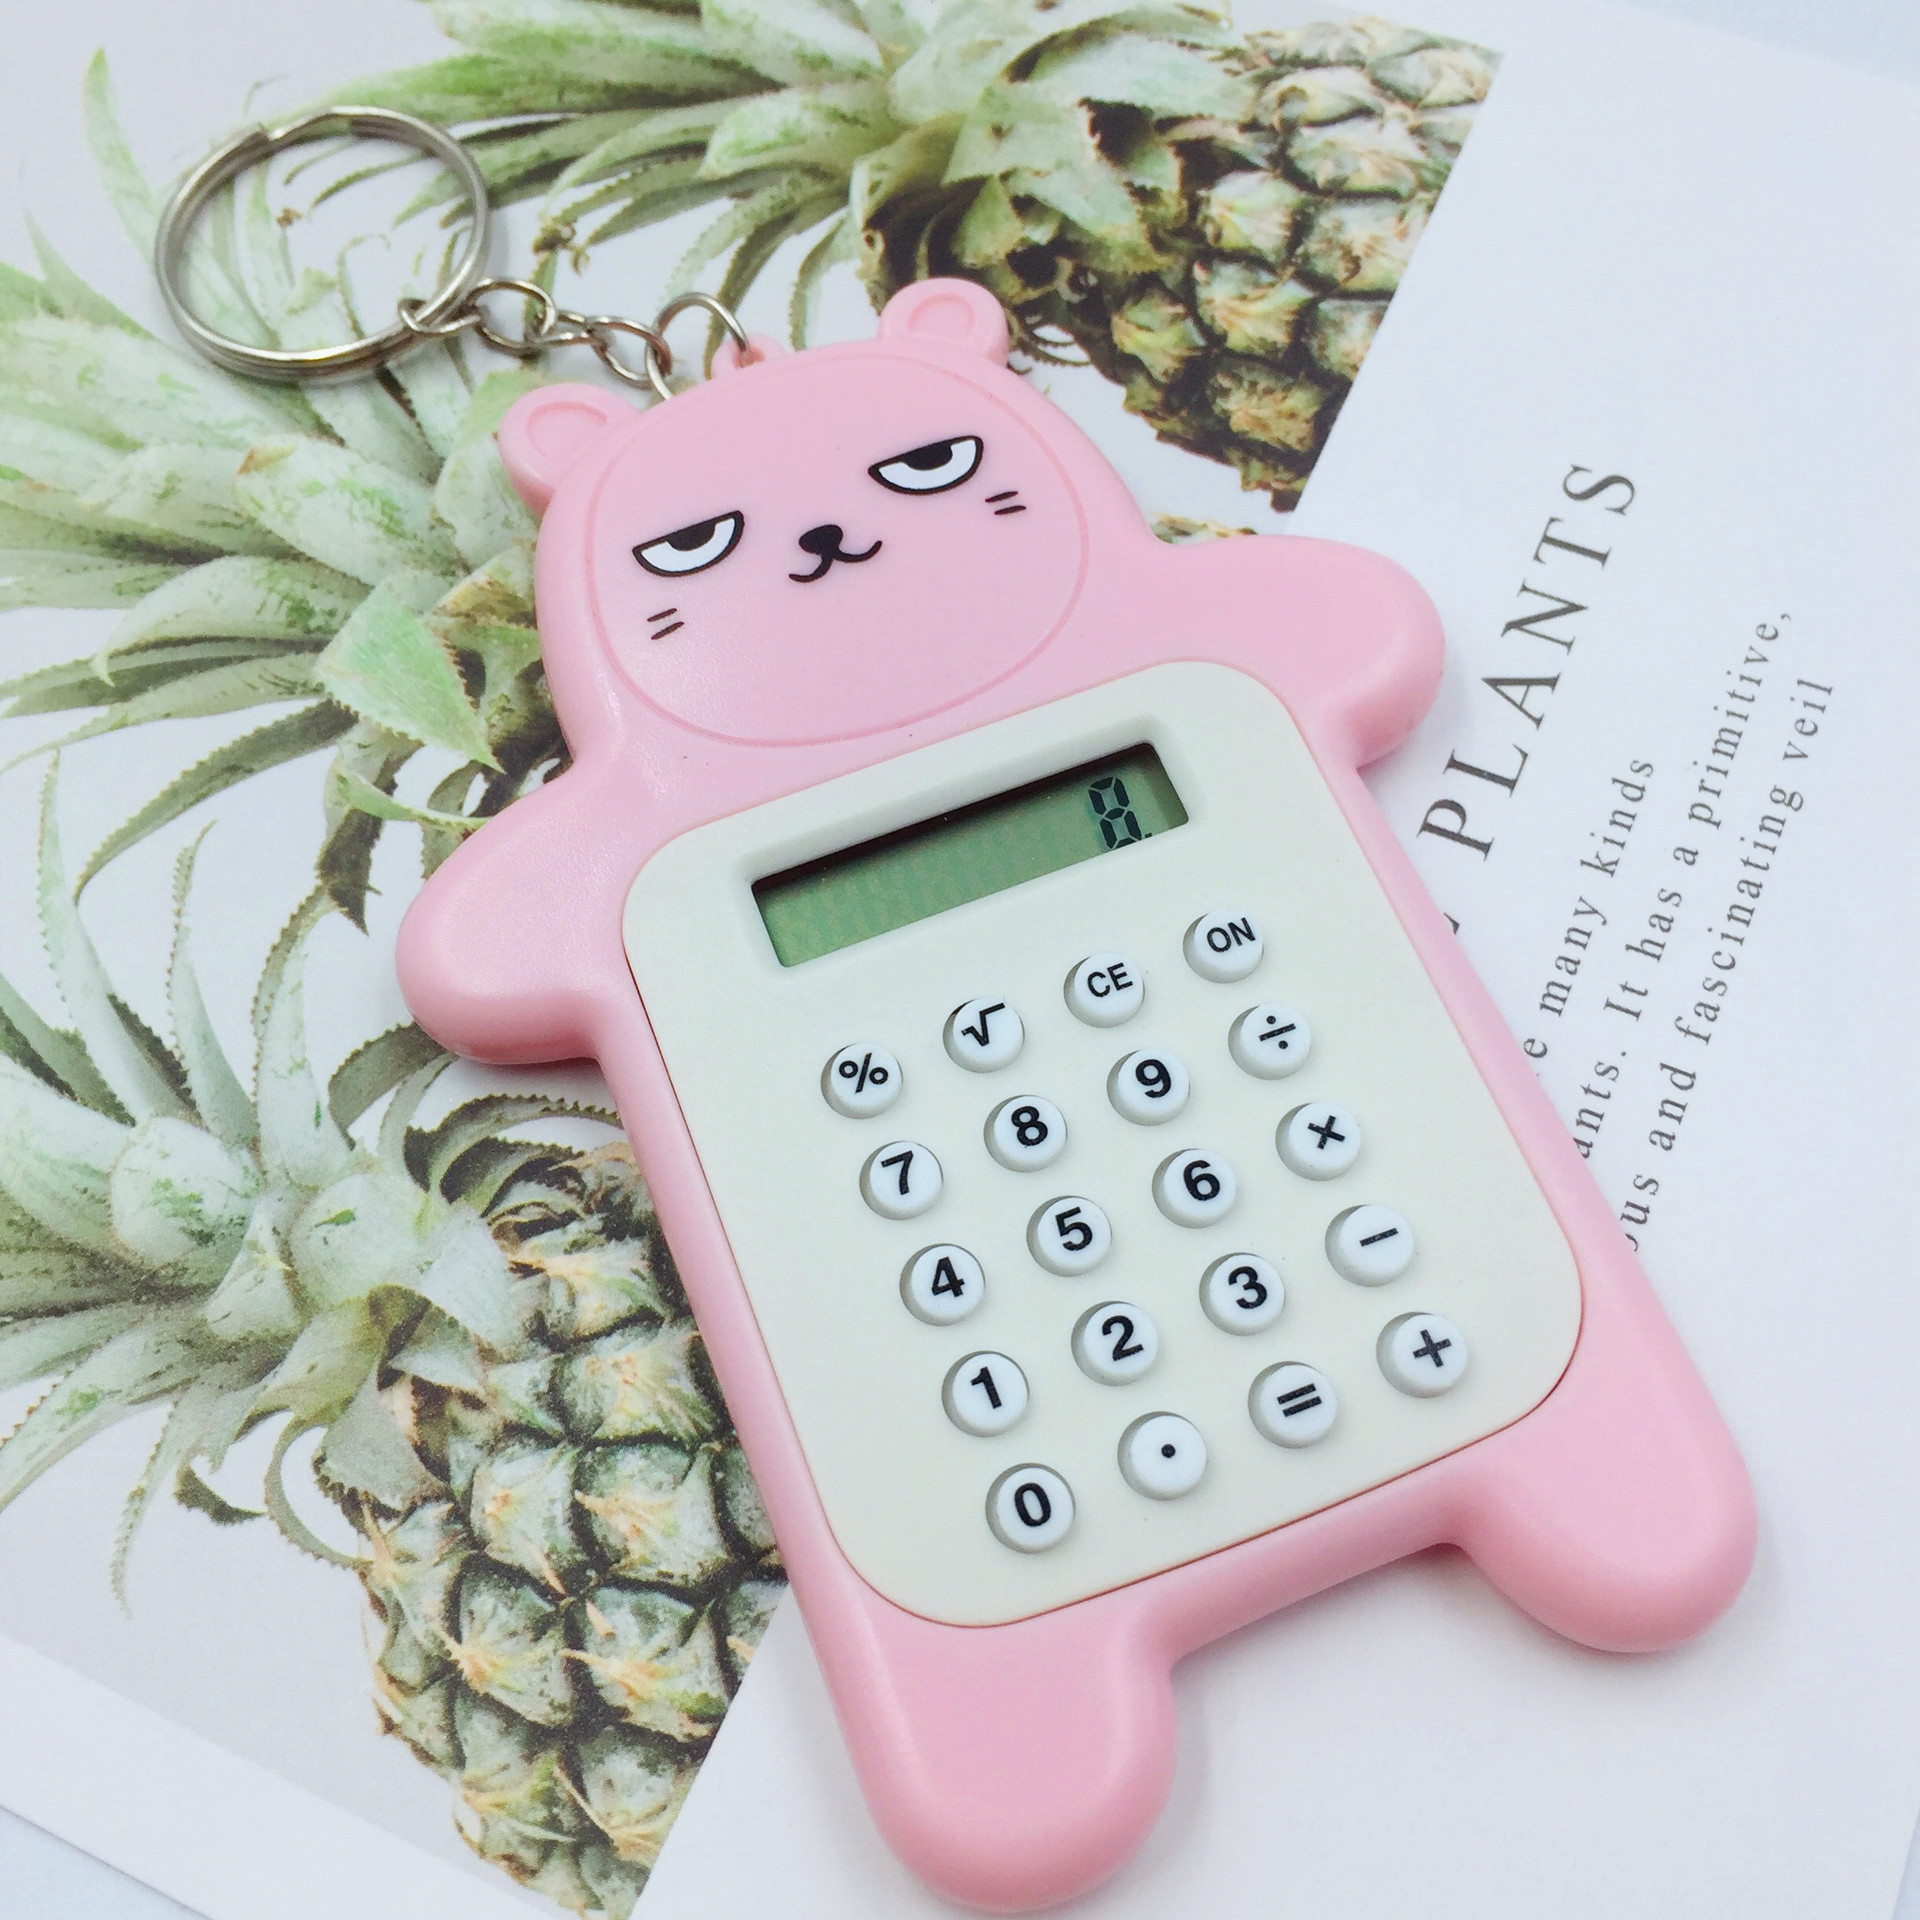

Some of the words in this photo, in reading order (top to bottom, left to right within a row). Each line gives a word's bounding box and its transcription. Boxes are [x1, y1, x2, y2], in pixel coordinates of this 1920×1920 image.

[1416, 464, 1636, 861] PLANTS
[1687, 612, 1791, 830] primitive,
[1540, 896, 1608, 1018] many
[1579, 759, 1654, 878] kinds
[1625, 887, 1683, 963] has
[1648, 1062, 1697, 1152] and
[1674, 785, 1804, 1046] fascinating
[1782, 678, 1833, 762] veil
[1673, 846, 1700, 866] a
[838, 1052, 889, 1093] %
[1086, 962, 1133, 998] CE
[1206, 916, 1256, 953] ON
[1603, 980, 1649, 1022] It
[880, 1150, 914, 1195] 7
[1011, 1106, 1048, 1147] 8
[1135, 1059, 1172, 1099] 9
[931, 1256, 965, 1298] 4
[1055, 1206, 1093, 1251] 5
[1183, 1160, 1220, 1201] 6
[970, 1366, 1002, 1409] 1
[1102, 1315, 1144, 1361] 2
[1228, 1266, 1268, 1309] 3
[1014, 1482, 1051, 1527] 0
